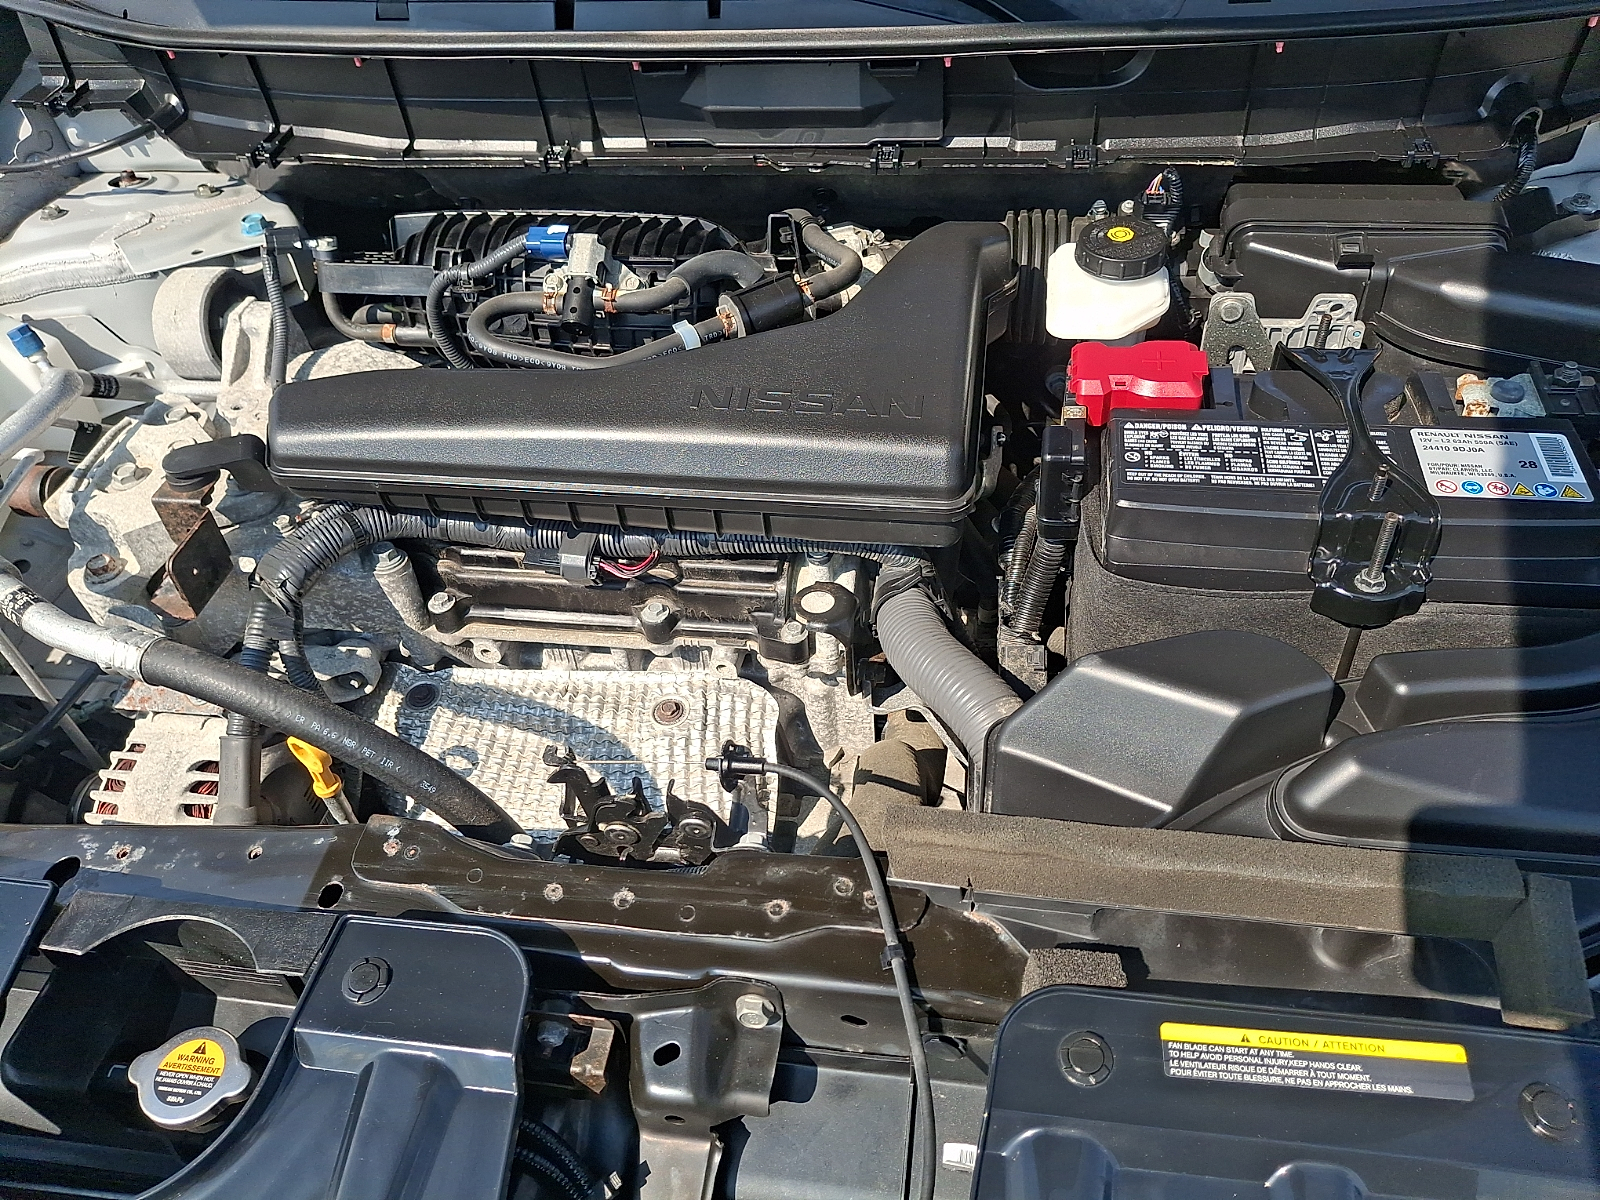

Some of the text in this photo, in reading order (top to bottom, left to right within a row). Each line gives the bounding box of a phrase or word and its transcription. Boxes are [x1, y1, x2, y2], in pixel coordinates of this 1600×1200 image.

[690, 384, 925, 419] NISSAN
[1134, 422, 1187, 430] DANGER/POISON
[1518, 460, 1538, 469] 28
[361, 746, 376, 758] PET
[1184, 1043, 1208, 1051] BLADE
[1209, 1045, 1225, 1053] CAN
[1225, 1046, 1248, 1055] START
[1276, 1050, 1294, 1058] TIME.
[1258, 1035, 1309, 1047] CAUTION
[1323, 1041, 1385, 1053] ATTENTION
[177, 1053, 215, 1065] WARNING
[1169, 1050, 1179, 1058] TO
[1181, 1051, 1200, 1059] HELP
[1201, 1052, 1222, 1061] AVOID
[1224, 1055, 1263, 1064] PERSONAL
[1309, 1061, 1335, 1070] HANDS
[1337, 1063, 1363, 1071] CLEAR.
[163, 1062, 221, 1074] AVERTISSEMENT
[1180, 1061, 1227, 1071] VENTILATEUR
[1228, 1064, 1255, 1073] RISQUE
[1257, 1066, 1267, 1074] DE
[1268, 1066, 1308, 1076] DÉMARRER
[1317, 1071, 1336, 1079] TOUT
[1337, 1073, 1372, 1082] MOMENT.
[1170, 1068, 1414, 1094] POUR ÉVITER TOUTE BLESSURE, NE PAS EN APPROCHER LES MAINS.
